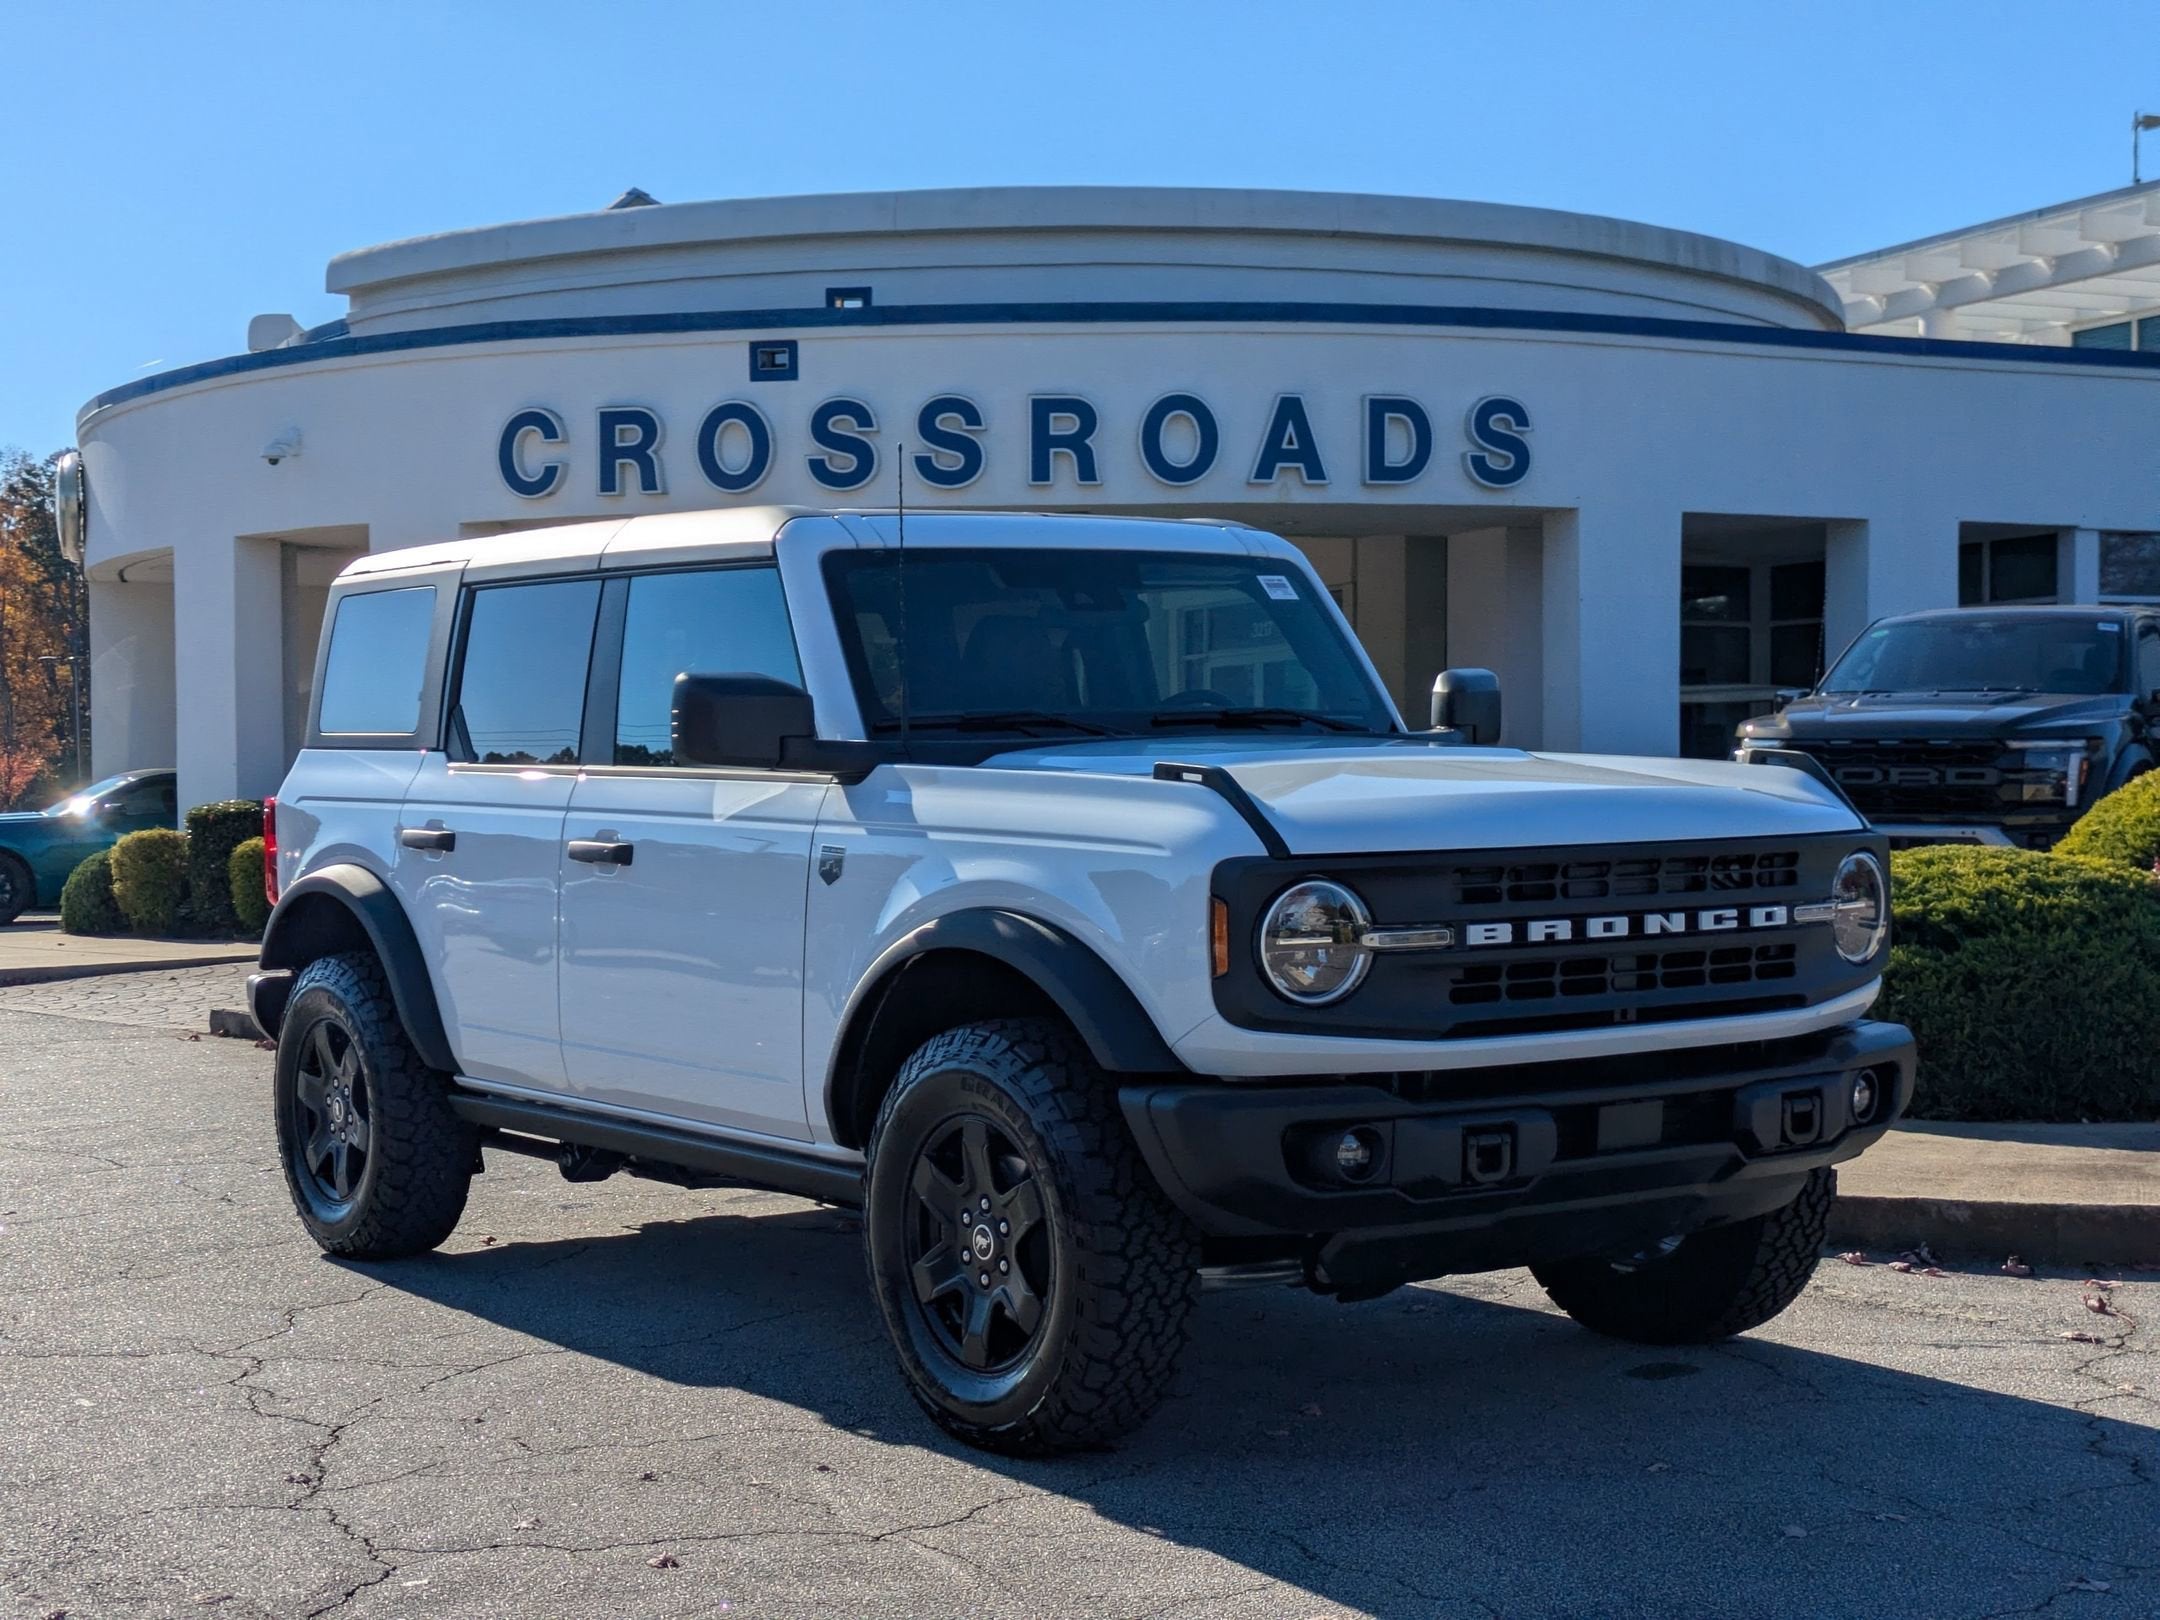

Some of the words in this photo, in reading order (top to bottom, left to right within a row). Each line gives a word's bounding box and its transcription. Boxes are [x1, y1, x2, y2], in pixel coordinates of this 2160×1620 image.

[498, 391, 1533, 499] CROSSROADS
[1835, 766, 2000, 785] ORD
[1466, 905, 1788, 945] BRONCO
